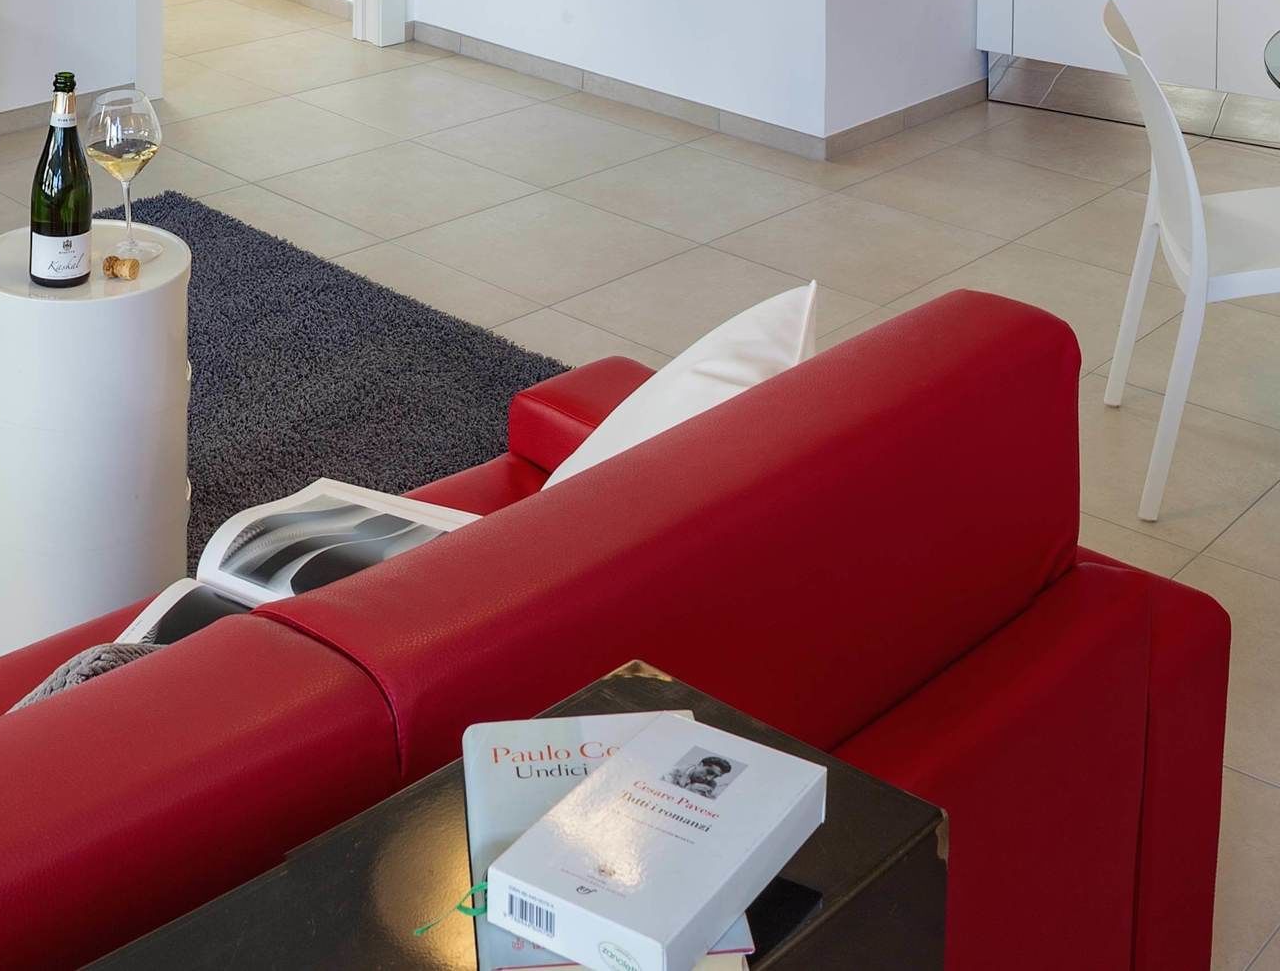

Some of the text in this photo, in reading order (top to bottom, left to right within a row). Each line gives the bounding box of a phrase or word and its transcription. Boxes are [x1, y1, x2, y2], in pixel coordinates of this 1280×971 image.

[492, 744, 571, 764] Paulo
[516, 764, 588, 779] Undici
[633, 780, 720, 819] Cesare Pavese
[658, 807, 712, 833] romanzi
